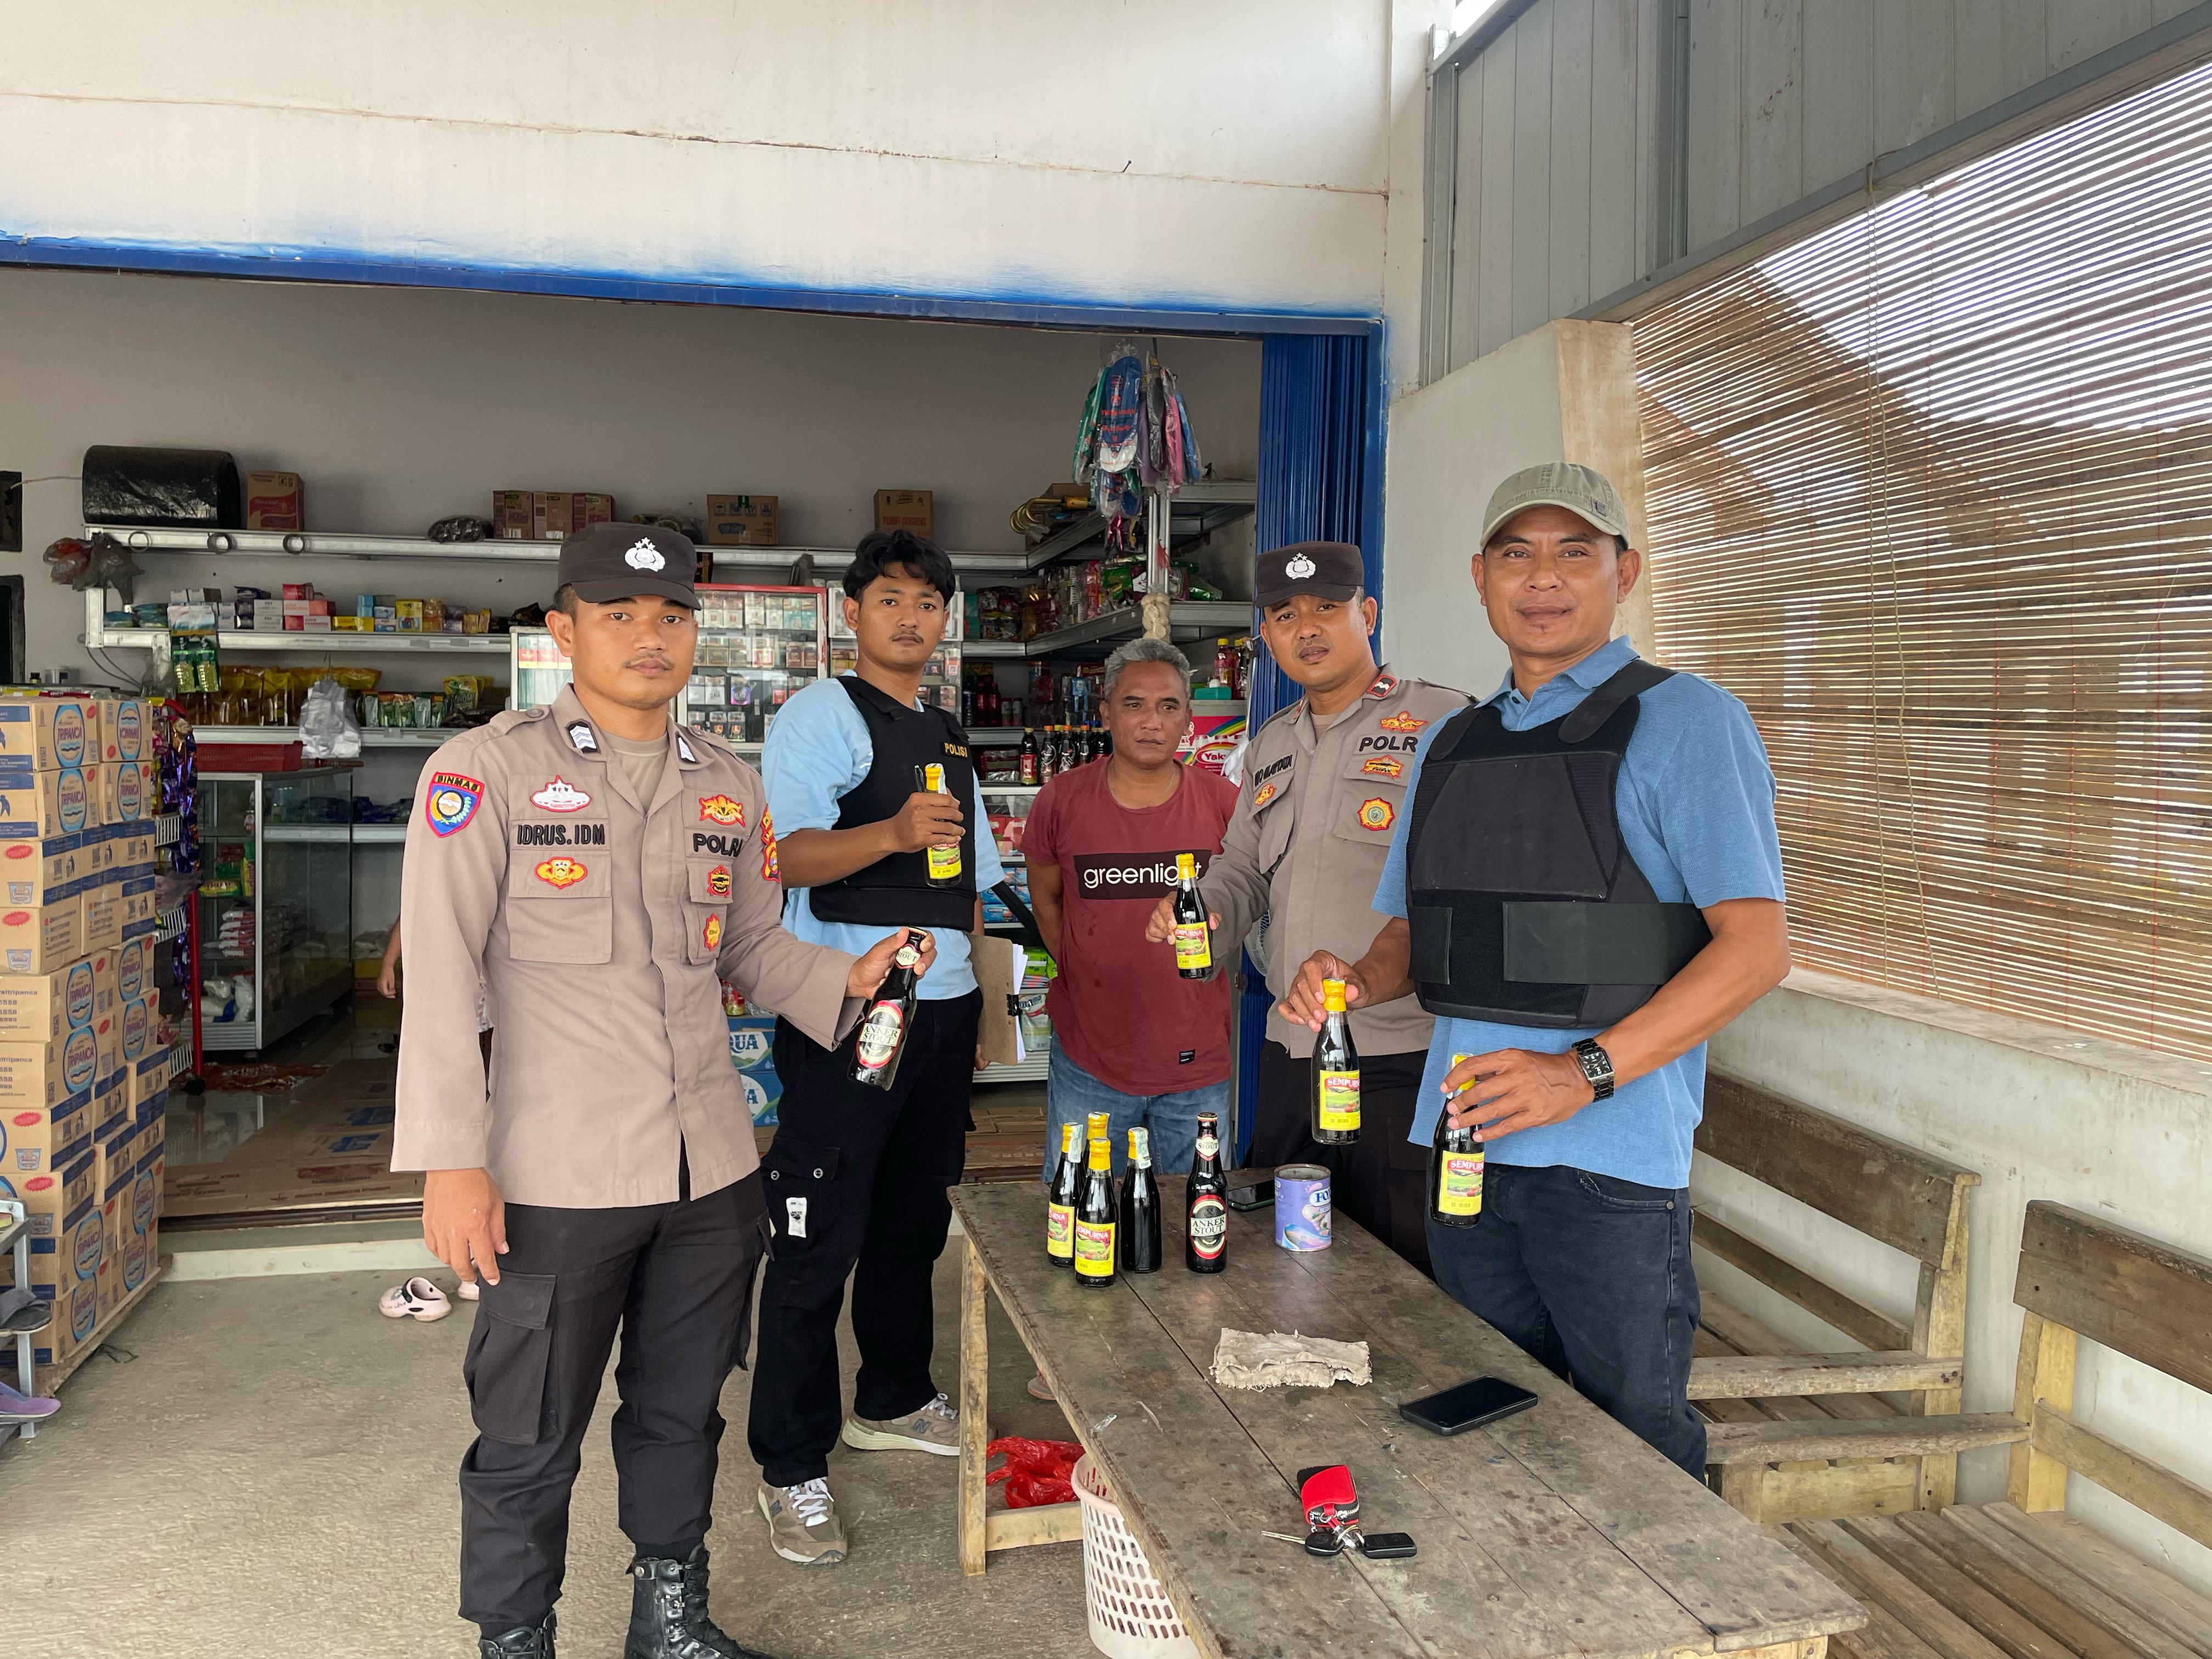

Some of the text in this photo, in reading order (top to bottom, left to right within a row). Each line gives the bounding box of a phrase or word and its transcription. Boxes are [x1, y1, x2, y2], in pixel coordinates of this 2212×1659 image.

[57, 727, 82, 744] TRIPANCA
[944, 742, 968, 758] POLISI
[1359, 736, 1418, 753] POLR
[120, 783, 139, 795] TRIPANCA
[437, 775, 478, 792] BINMAS
[61, 791, 84, 811] TRIPANCA
[517, 824, 605, 845] IDRUS.IDM
[1084, 862, 1202, 889] greenligt
[896, 951, 917, 962] STOUT
[69, 983, 92, 1005] TRIPANCA
[863, 1032, 894, 1045] STOUT
[864, 1025, 898, 1038] ANKER
[67, 1046, 94, 1071] TRIPANCA
[1192, 1217, 1225, 1228] ANKER
[1194, 1224, 1223, 1235] STOUT
